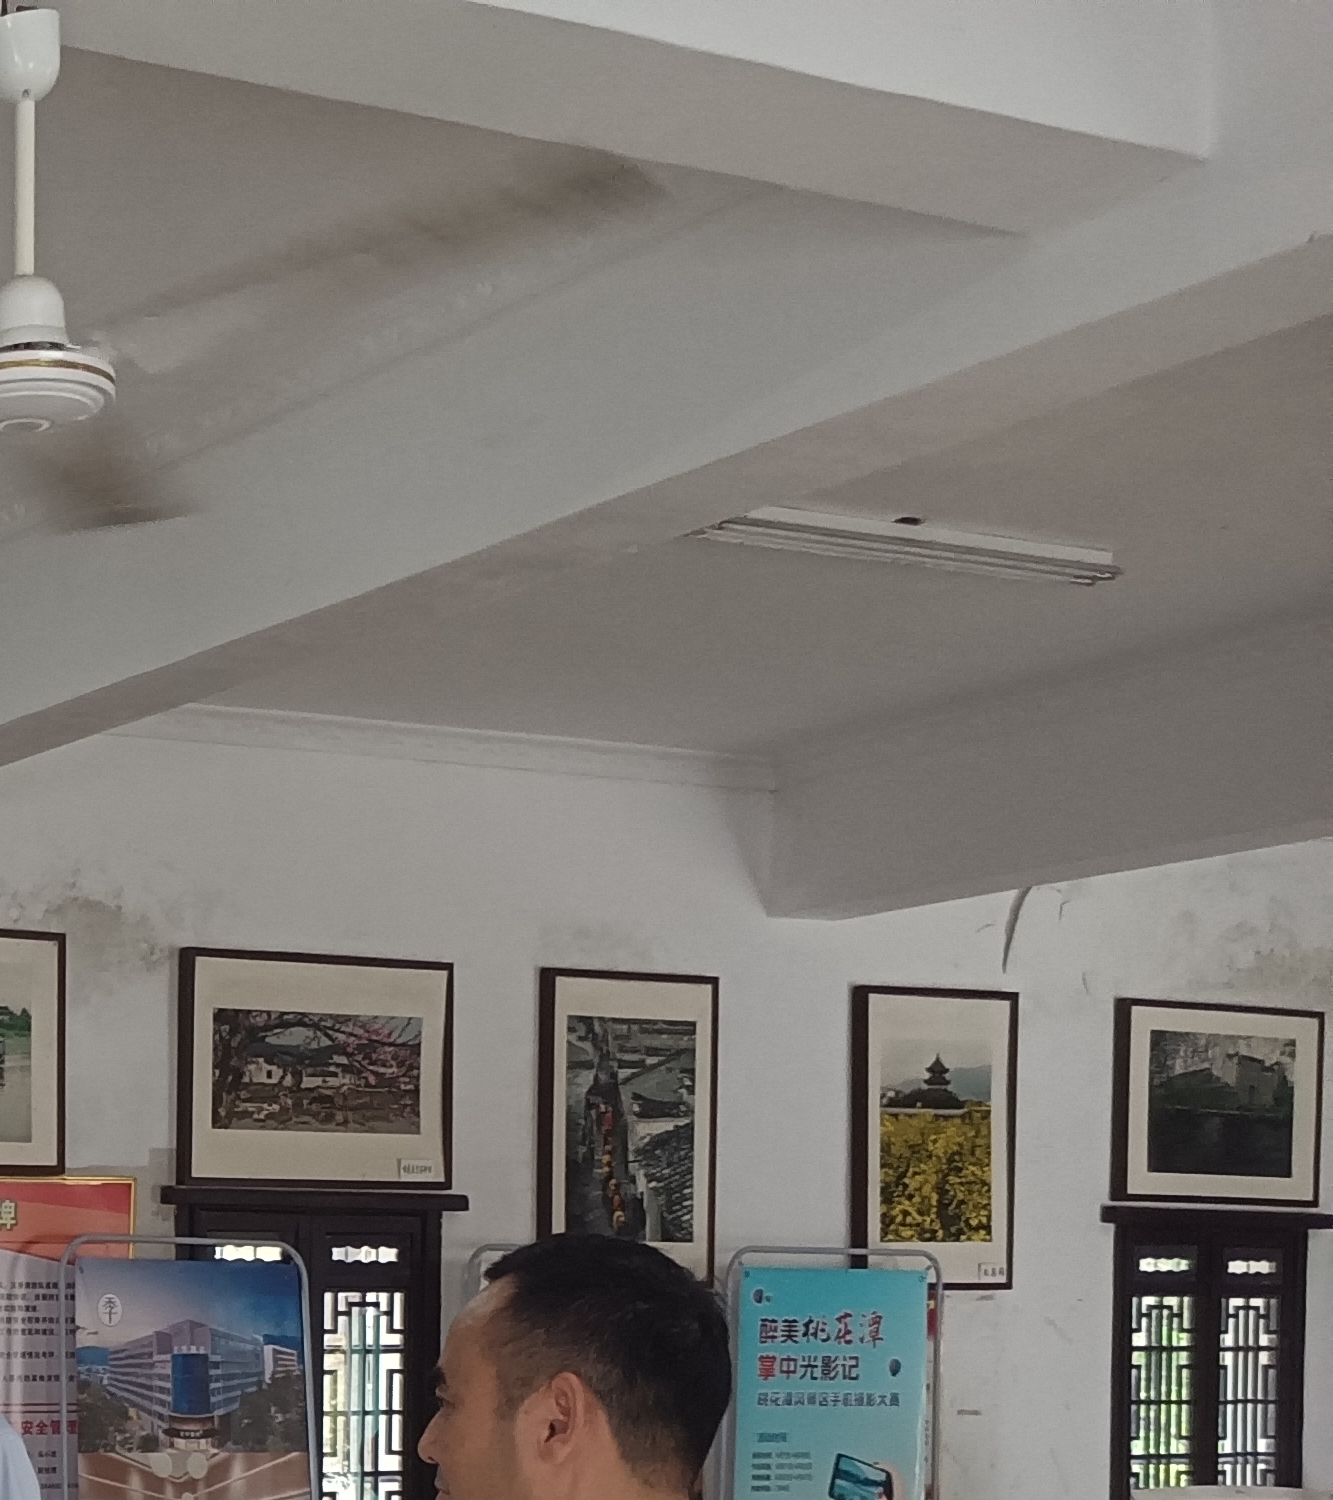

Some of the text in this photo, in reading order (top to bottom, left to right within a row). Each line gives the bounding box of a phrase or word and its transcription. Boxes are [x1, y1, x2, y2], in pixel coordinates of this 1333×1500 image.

[757, 1310, 886, 1348] 醉美桃花潭
[756, 1354, 861, 1382] 掌中光影记
